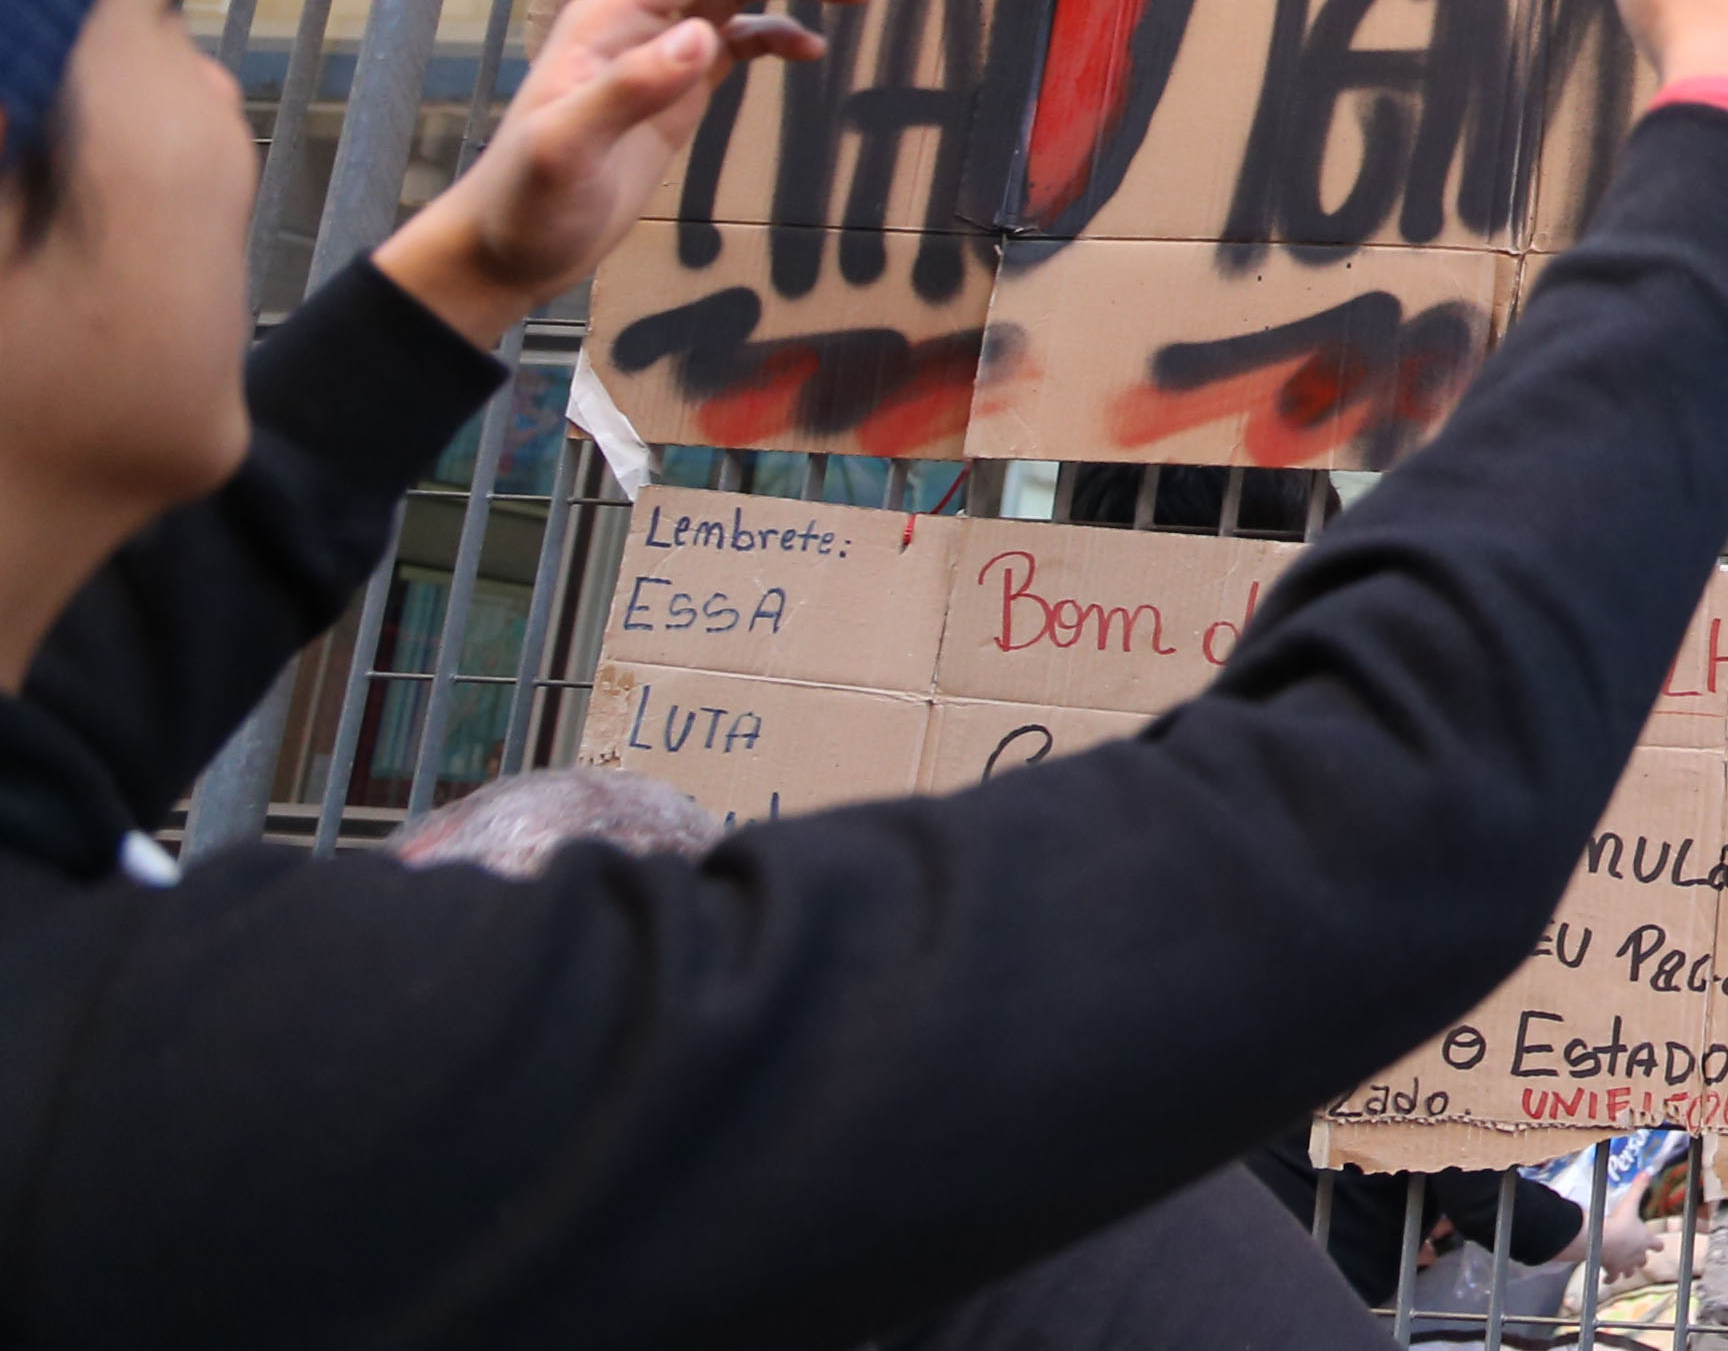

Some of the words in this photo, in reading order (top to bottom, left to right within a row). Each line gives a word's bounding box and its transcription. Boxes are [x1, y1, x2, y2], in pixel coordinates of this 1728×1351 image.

[645, 504, 853, 559] Lembrete:
[624, 575, 788, 634] ESSA
[977, 550, 1176, 654] Bom
[628, 683, 763, 754] LUTA
